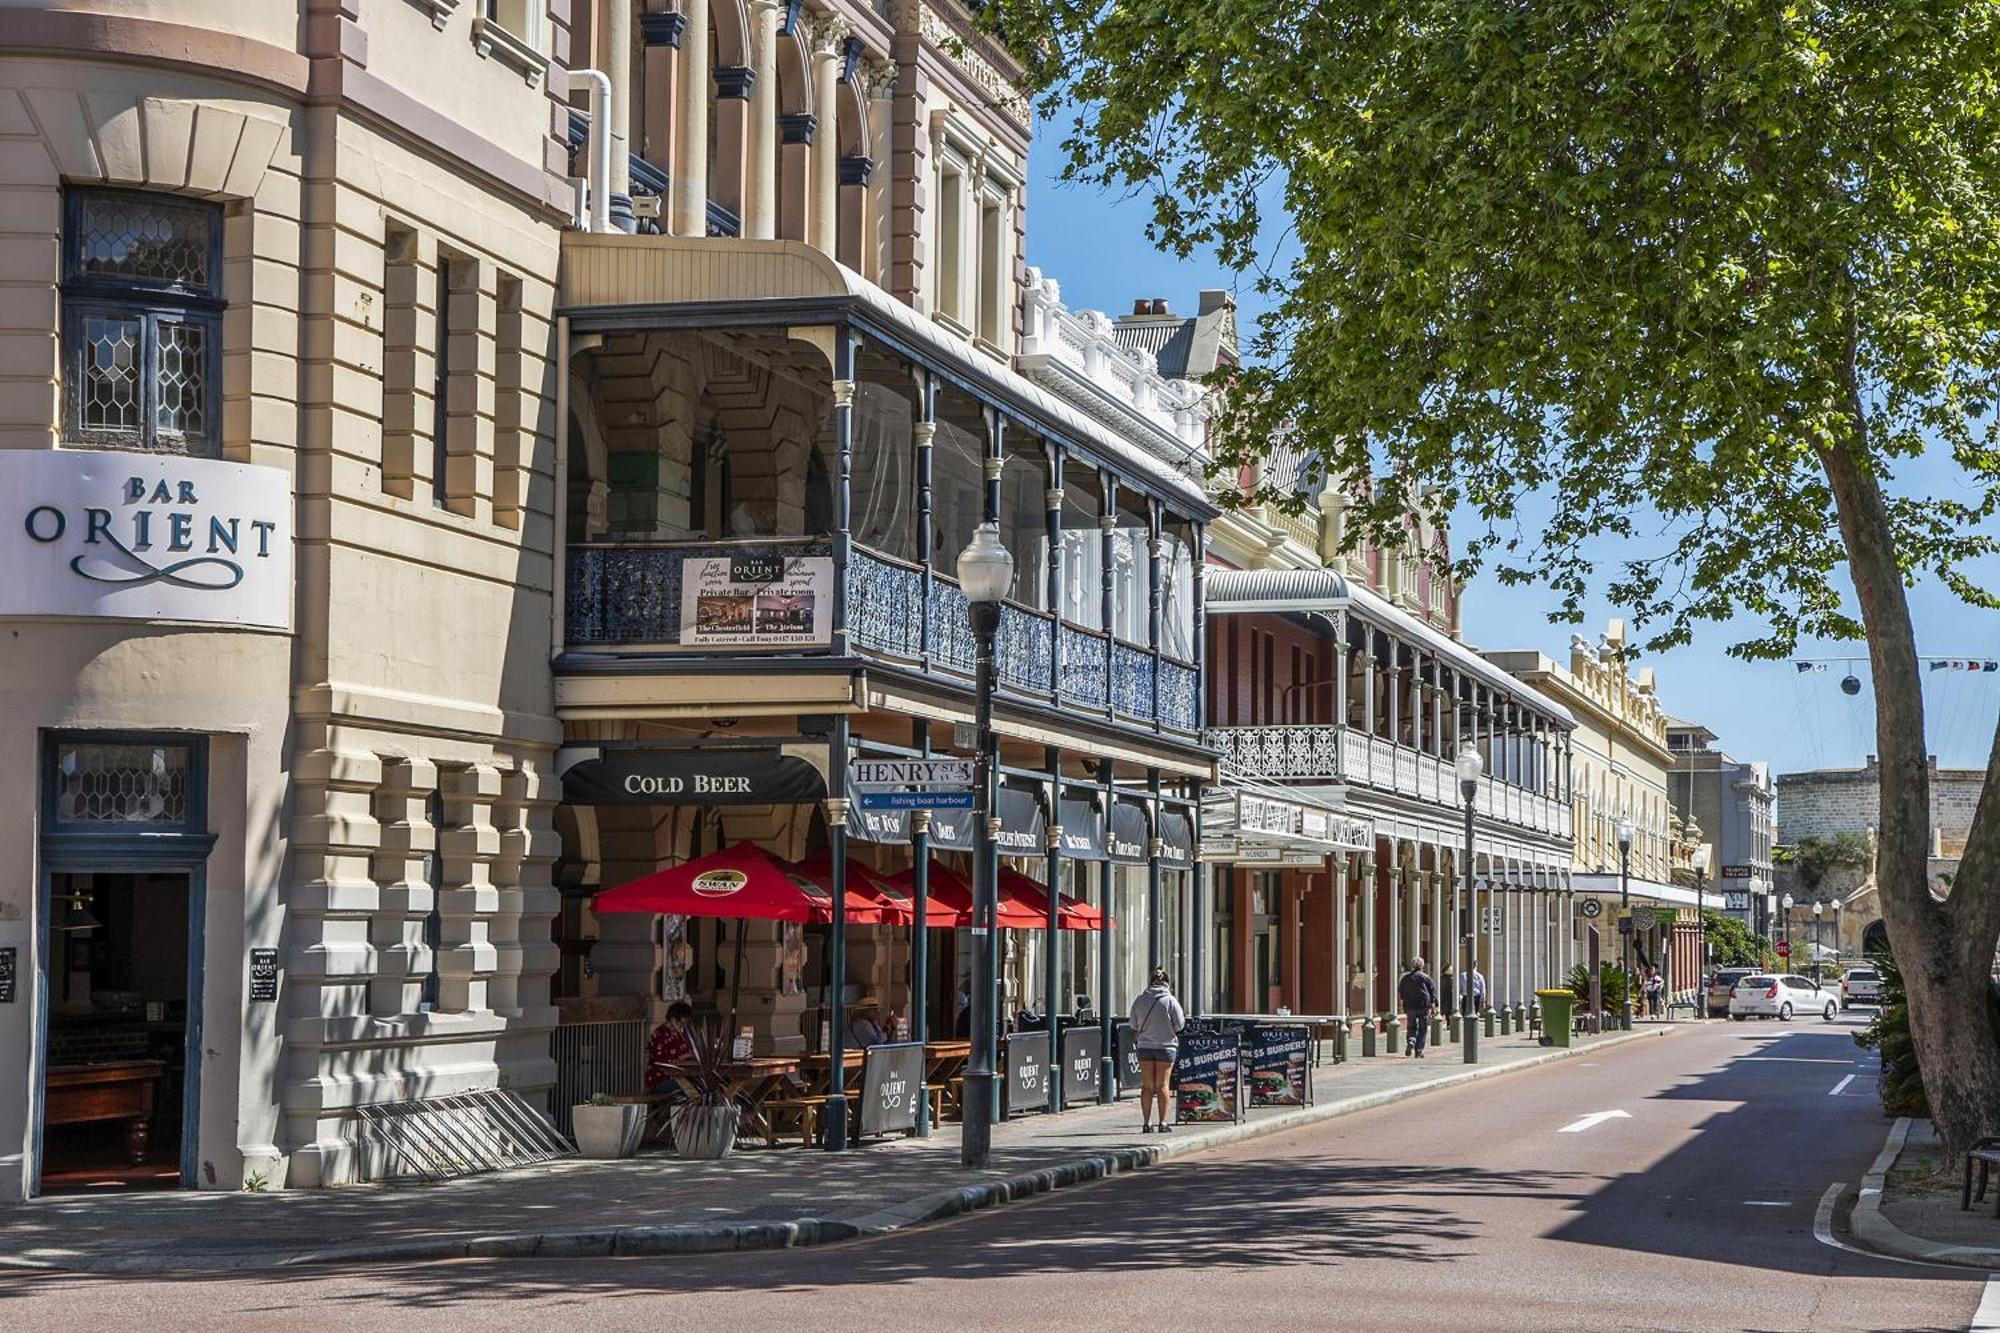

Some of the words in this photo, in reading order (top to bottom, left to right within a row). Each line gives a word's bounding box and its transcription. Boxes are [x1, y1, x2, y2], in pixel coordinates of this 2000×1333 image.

[128, 476, 199, 504] BAR
[25, 506, 276, 575] ORIENT
[733, 565, 781, 577] ORIENT
[701, 588, 732, 596] Private
[734, 588, 750, 596] Bar
[856, 763, 937, 782] HENRY
[624, 775, 683, 793] COLD
[693, 775, 752, 793] BEER
[891, 797, 915, 806] fishing
[936, 797, 967, 805] harbour
[1179, 1058, 1191, 1069] $5
[1193, 1047, 1237, 1065] BURGERS
[1253, 1048, 1264, 1058] $5
[1267, 1040, 1306, 1055] BURGERS
[880, 1080, 906, 1100] ORIENT
